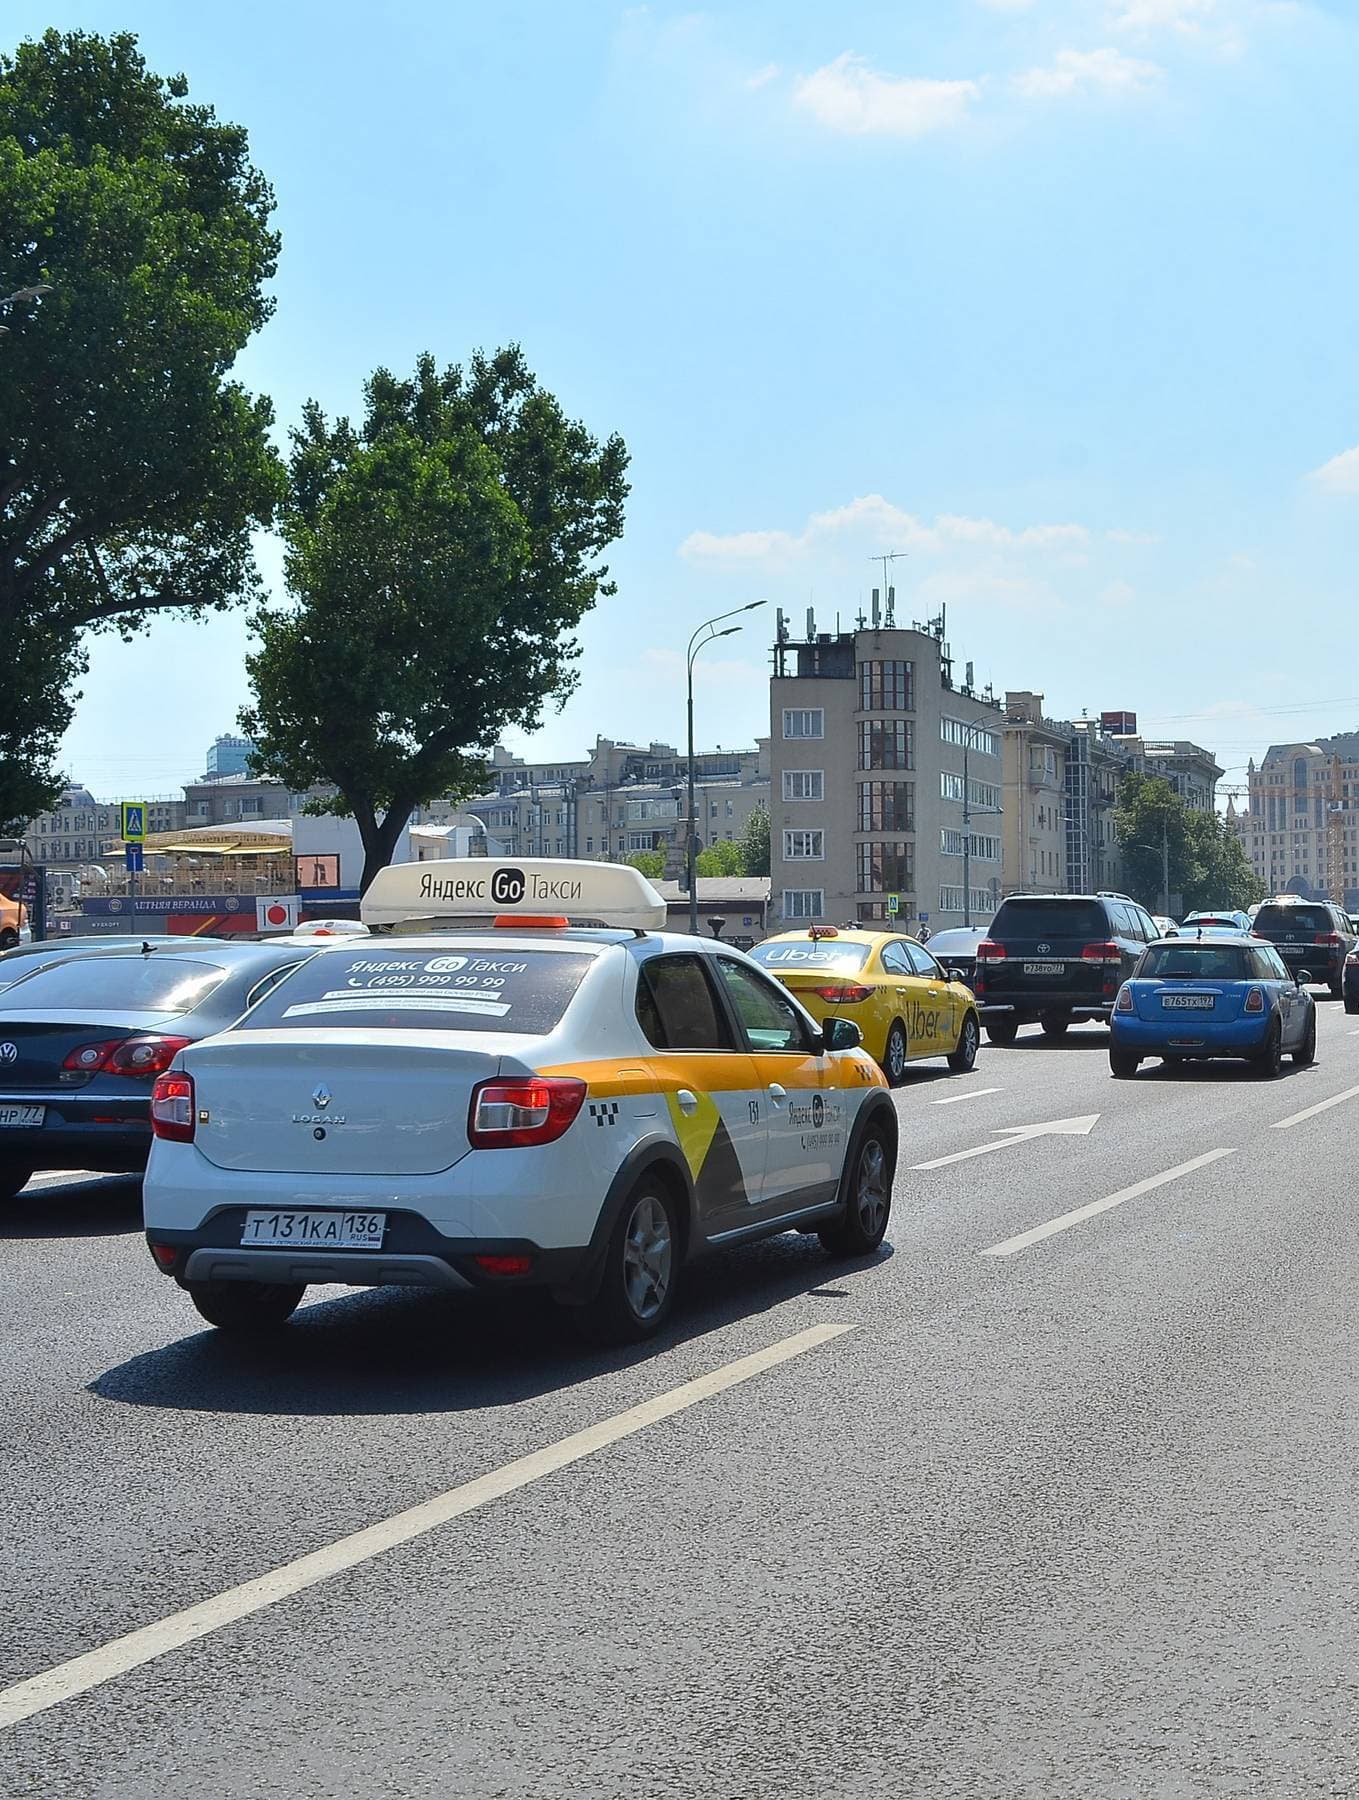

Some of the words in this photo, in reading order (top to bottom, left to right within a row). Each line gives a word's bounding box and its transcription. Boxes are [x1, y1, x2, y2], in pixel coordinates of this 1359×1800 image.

[419, 873, 486, 901] Яндекс
[494, 872, 522, 901] Go
[530, 873, 583, 900] Такси
[173, 900, 217, 910] ВЕРАНДА
[766, 949, 843, 961] Uber
[345, 959, 424, 974] Яндекс
[430, 958, 464, 971] Go
[468, 958, 528, 973] Такси
[367, 975, 416, 988] (495)
[418, 975, 452, 987] 999
[454, 976, 478, 987] 99
[480, 977, 506, 989] 99
[905, 1000, 941, 1041] Uber
[24, 1106, 40, 1119] 77
[292, 1113, 347, 1125] LOGAN
[252, 1214, 338, 1239] Т131КА
[345, 1215, 378, 1234] 136
[350, 1233, 368, 1241] RUS
